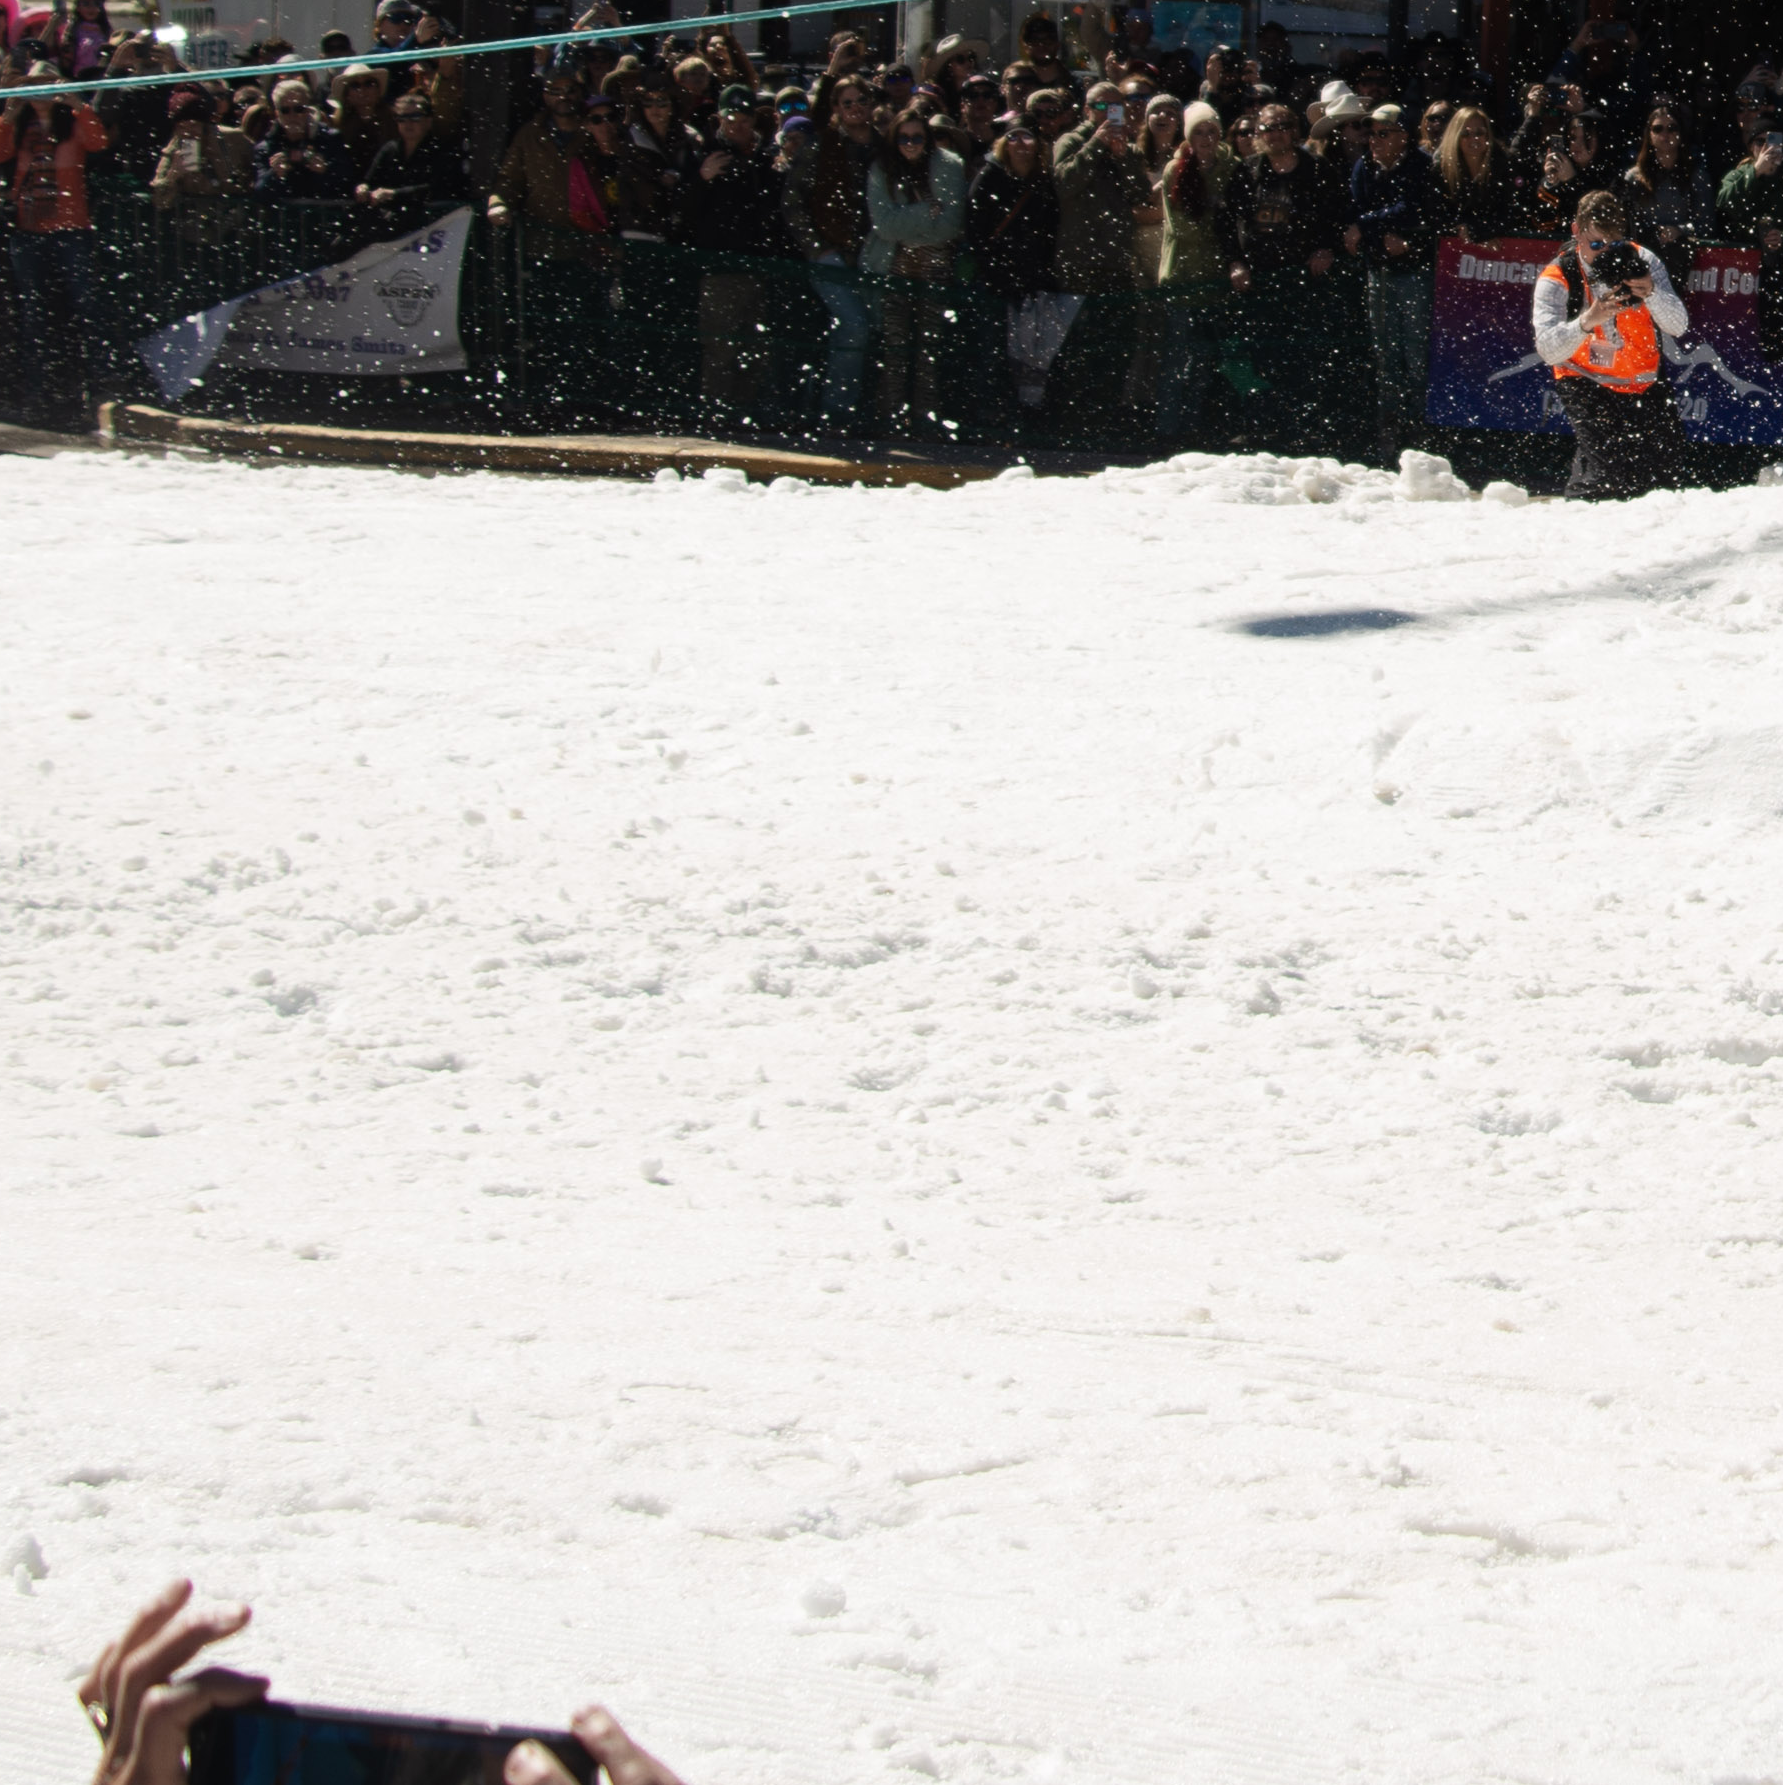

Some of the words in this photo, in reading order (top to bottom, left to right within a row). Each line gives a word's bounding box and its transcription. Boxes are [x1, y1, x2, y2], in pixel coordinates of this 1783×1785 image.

[1458, 254, 1545, 285] Dunca
[1687, 266, 1718, 293] nd
[377, 286, 436, 299] ASPEN
